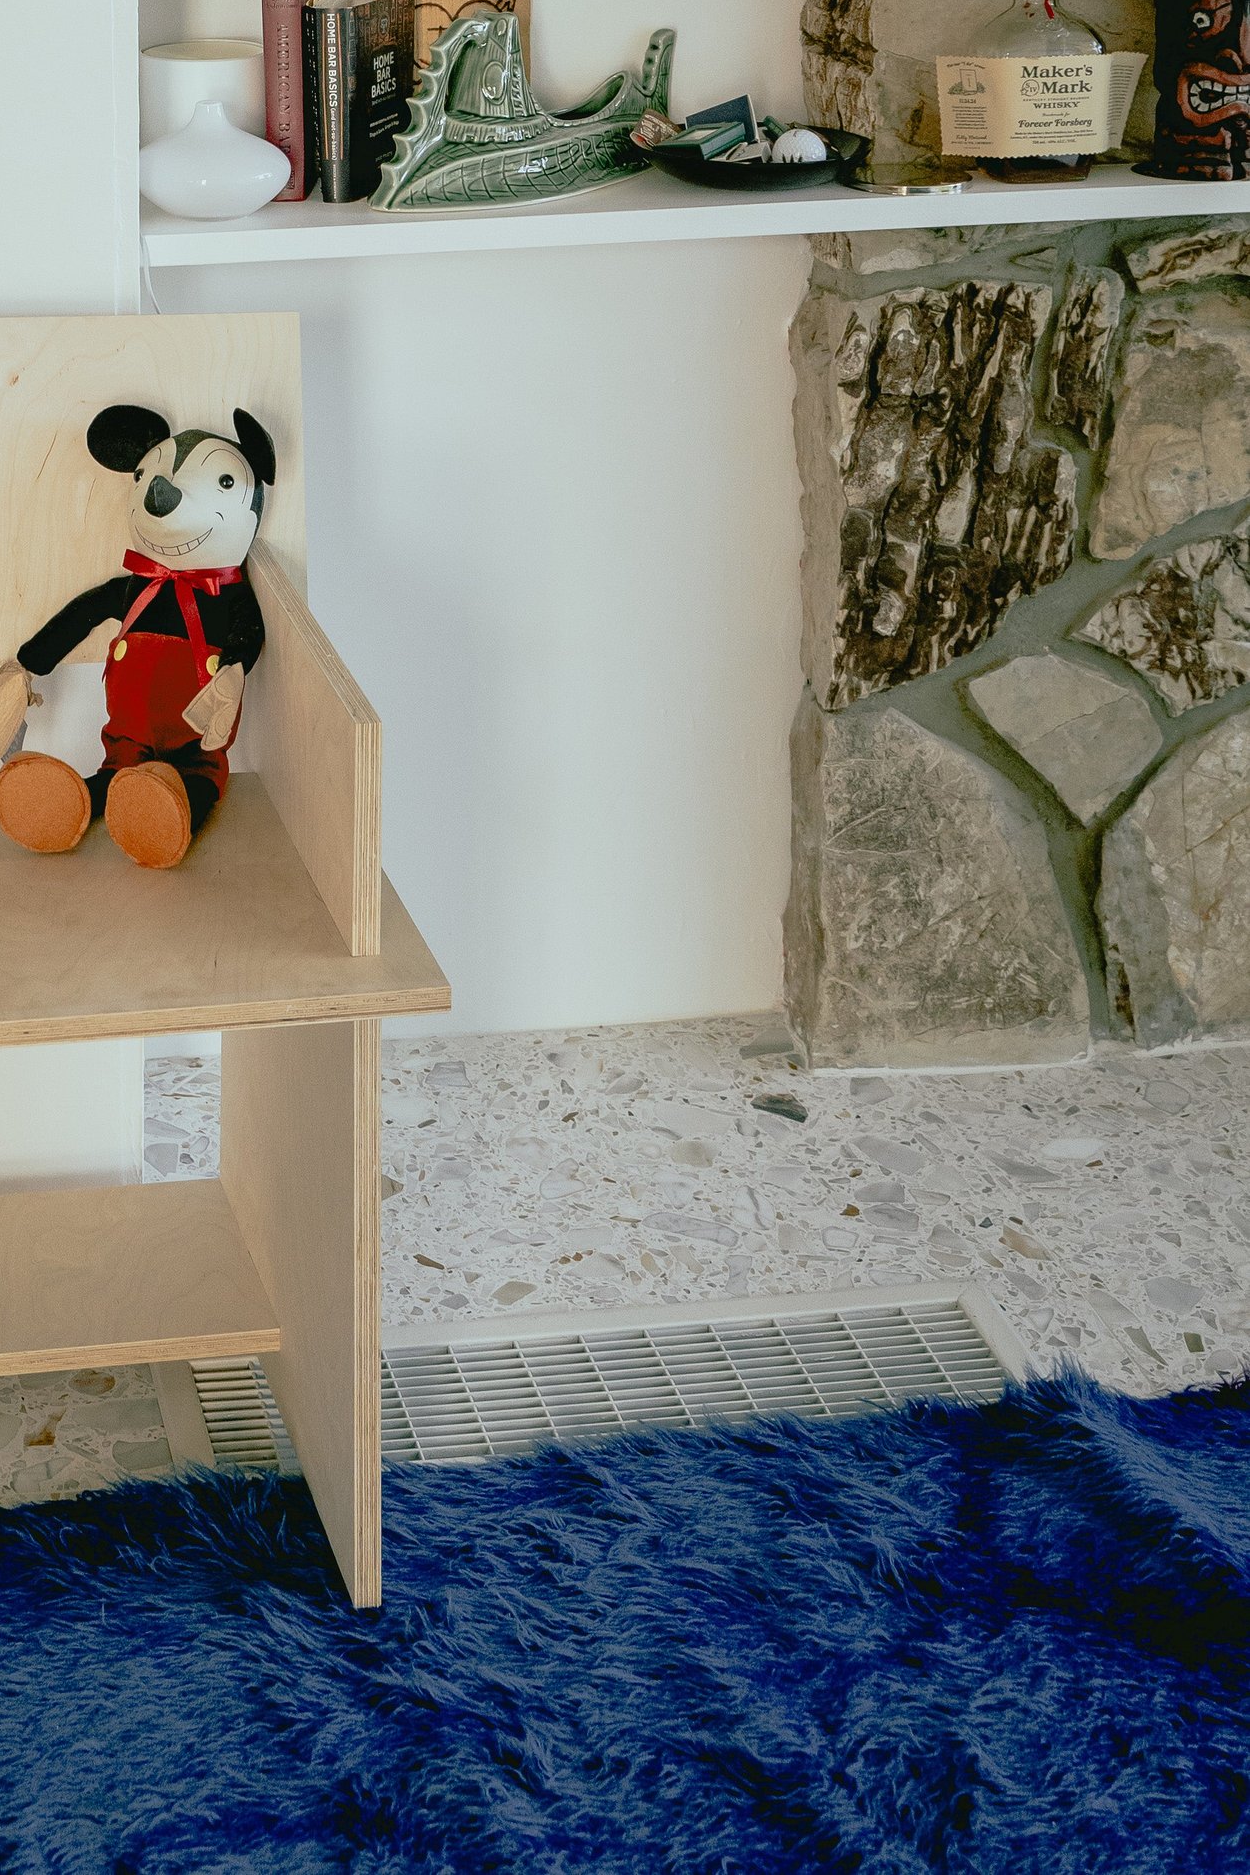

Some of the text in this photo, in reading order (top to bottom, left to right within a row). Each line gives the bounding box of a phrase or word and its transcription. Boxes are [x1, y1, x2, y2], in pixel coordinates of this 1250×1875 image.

[326, 13, 336, 44] HOME
[327, 46, 337, 68] BAR
[373, 51, 395, 70] HOME
[276, 22, 291, 115] AMERICAN
[377, 66, 391, 82] BAR
[1020, 64, 1093, 79] Maker's
[328, 70, 338, 107] BASICS
[371, 78, 397, 98] BASICS
[1040, 80, 1092, 95] Mark
[1032, 101, 1081, 109] WHISKY
[1018, 117, 1093, 128] Forever Forsberg
